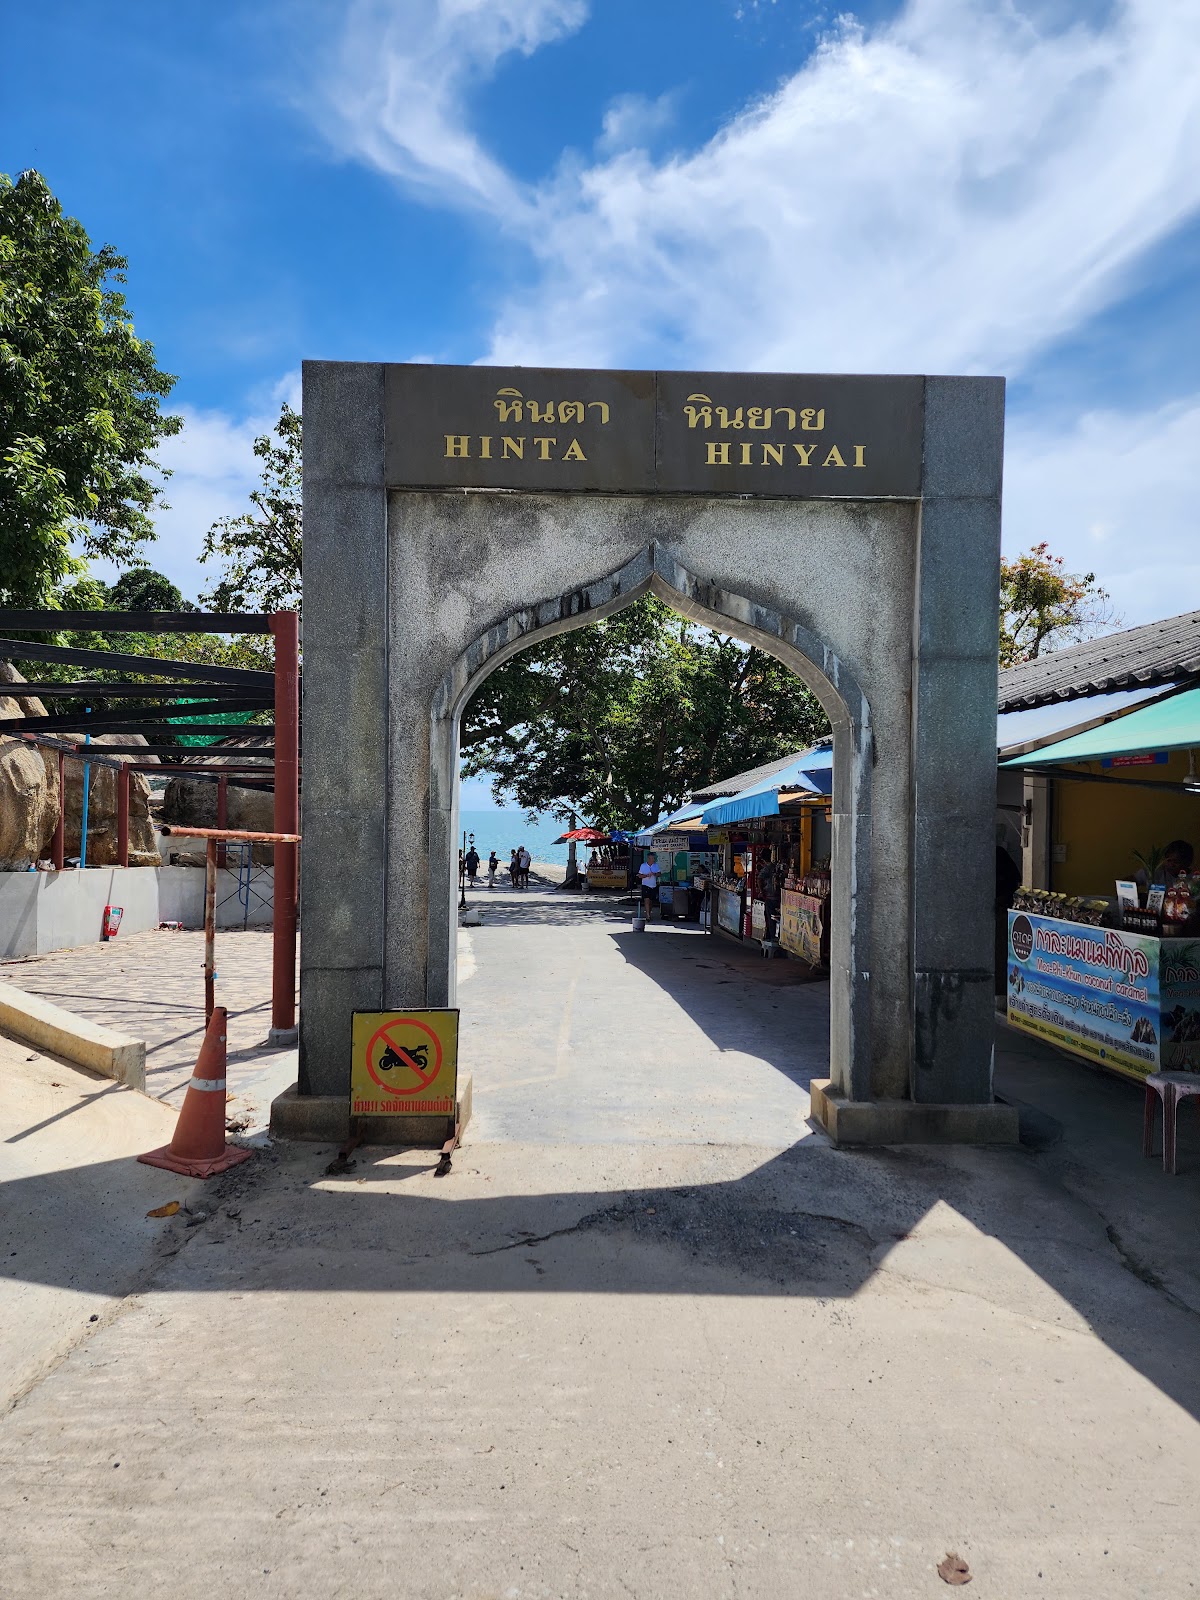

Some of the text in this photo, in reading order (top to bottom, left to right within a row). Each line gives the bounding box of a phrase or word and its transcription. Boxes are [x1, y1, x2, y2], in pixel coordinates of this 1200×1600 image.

[494, 387, 826, 431] หินตา หินยาย
[443, 434, 867, 469] HINTA HINYAI
[1012, 930, 1032, 945] OTOP
[1084, 974, 1113, 993] coconut
[1116, 982, 1148, 1003] caramel
[1165, 966, 1200, 983] กาล
